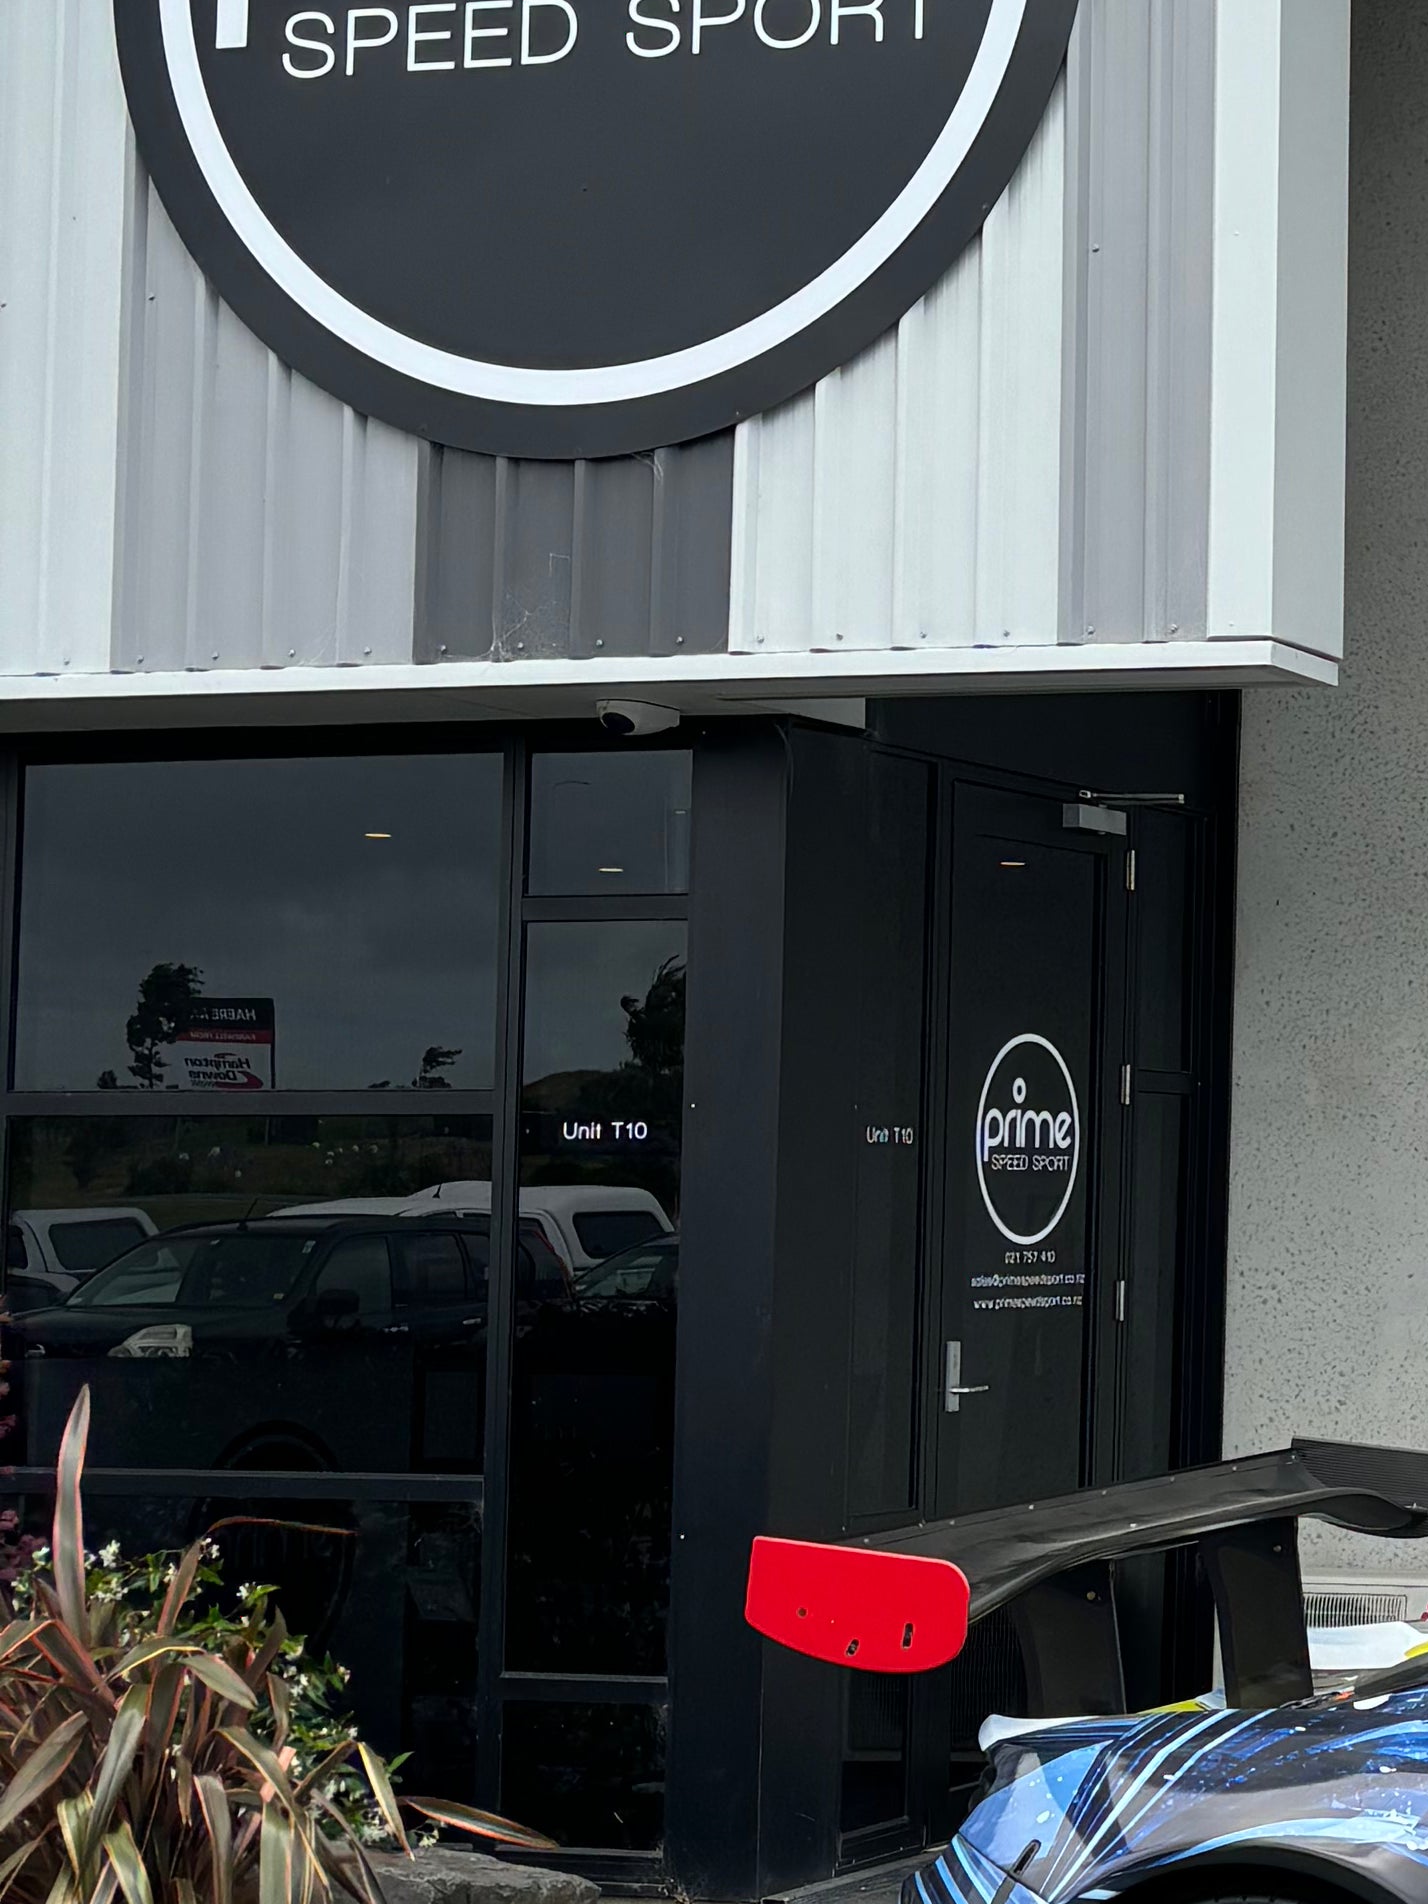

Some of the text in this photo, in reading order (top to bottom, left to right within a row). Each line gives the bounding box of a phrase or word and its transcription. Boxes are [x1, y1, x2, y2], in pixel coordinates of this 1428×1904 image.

[983, 1077, 1073, 1162] prime
[563, 1121, 648, 1140] Unit T10
[866, 1126, 914, 1145] Unit T10
[991, 1154, 1069, 1171] SPEED SPORT
